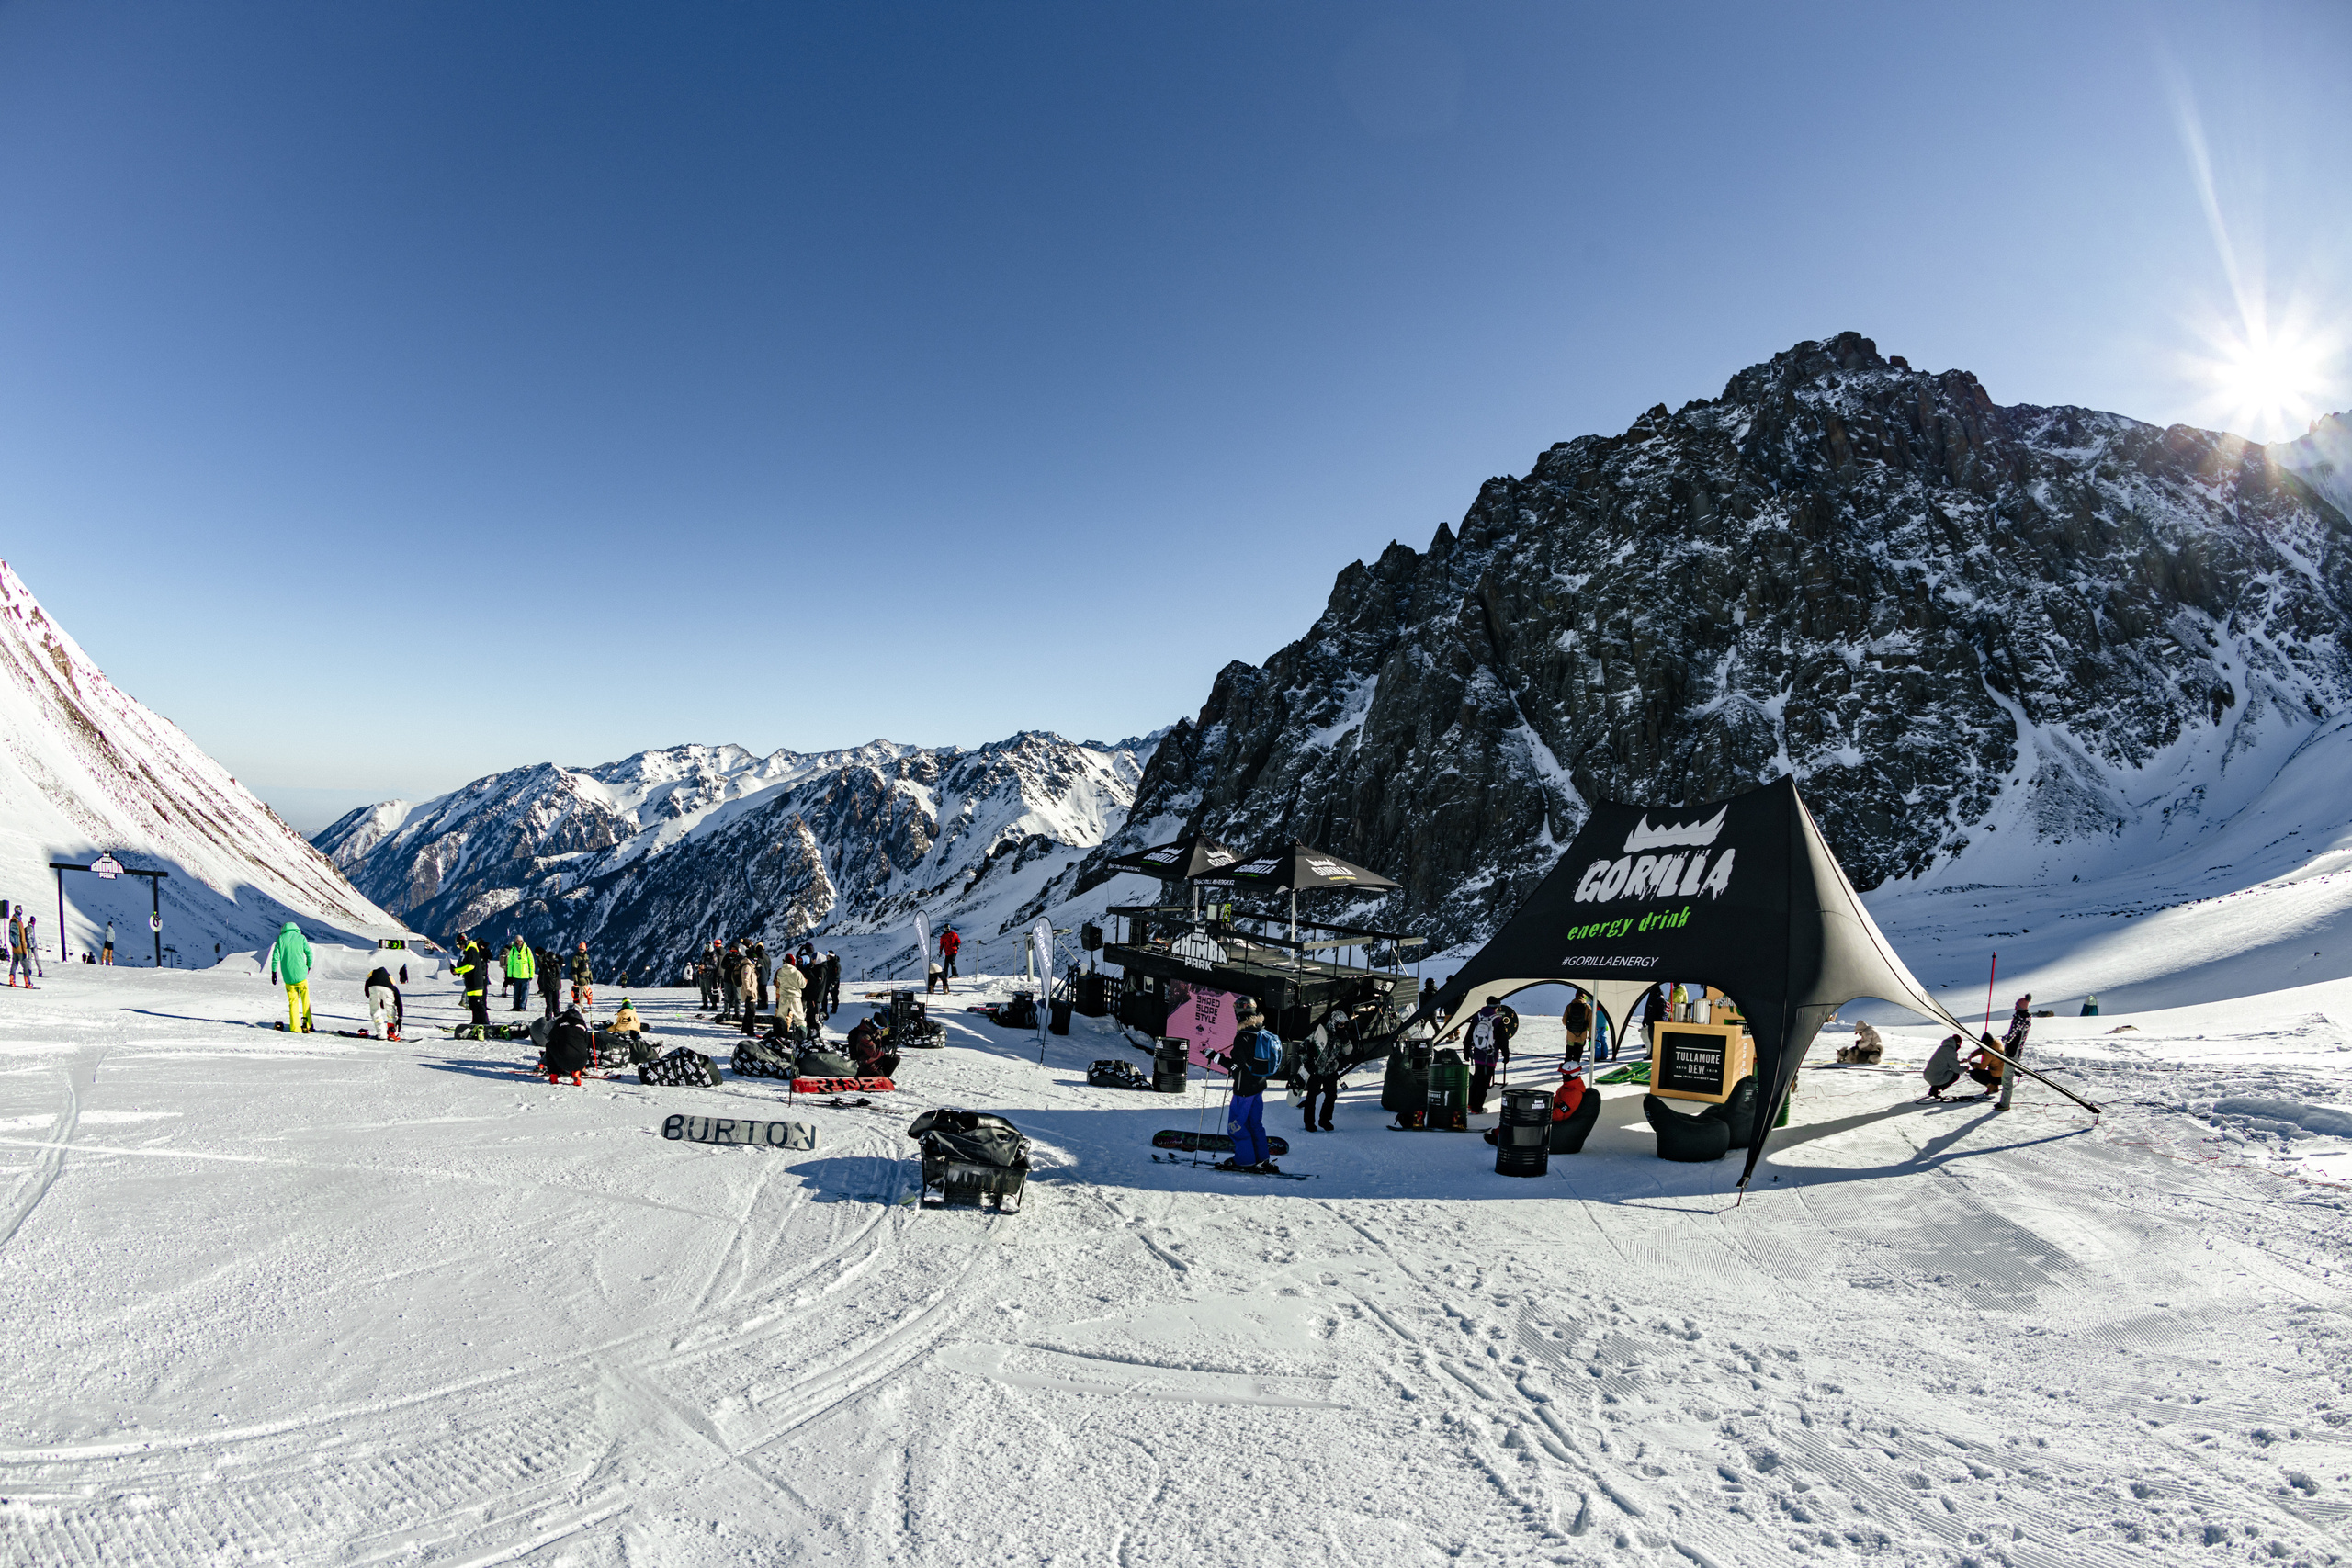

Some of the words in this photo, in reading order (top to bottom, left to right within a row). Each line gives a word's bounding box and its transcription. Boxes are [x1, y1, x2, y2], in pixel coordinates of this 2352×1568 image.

[1143, 852, 1180, 864] GORILLA
[1207, 856, 1237, 868] GORI
[1234, 864, 1278, 874] GORILLA
[1310, 865, 1357, 877] GORILLA
[1572, 848, 1736, 903] GORILLA
[1566, 917, 1634, 941] energy
[1637, 905, 1691, 933] drink
[1171, 933, 1229, 964] CHIMBA
[1184, 956, 1213, 972] PARK
[1562, 955, 1660, 967] #GORILLAENERGY
[1196, 995, 1221, 1009] SHRED
[1195, 1003, 1219, 1017] SLOPE
[1195, 1012, 1216, 1025] STYLE
[1675, 1051, 1721, 1065] TULLAMORE
[664, 1113, 817, 1150] BURTON
